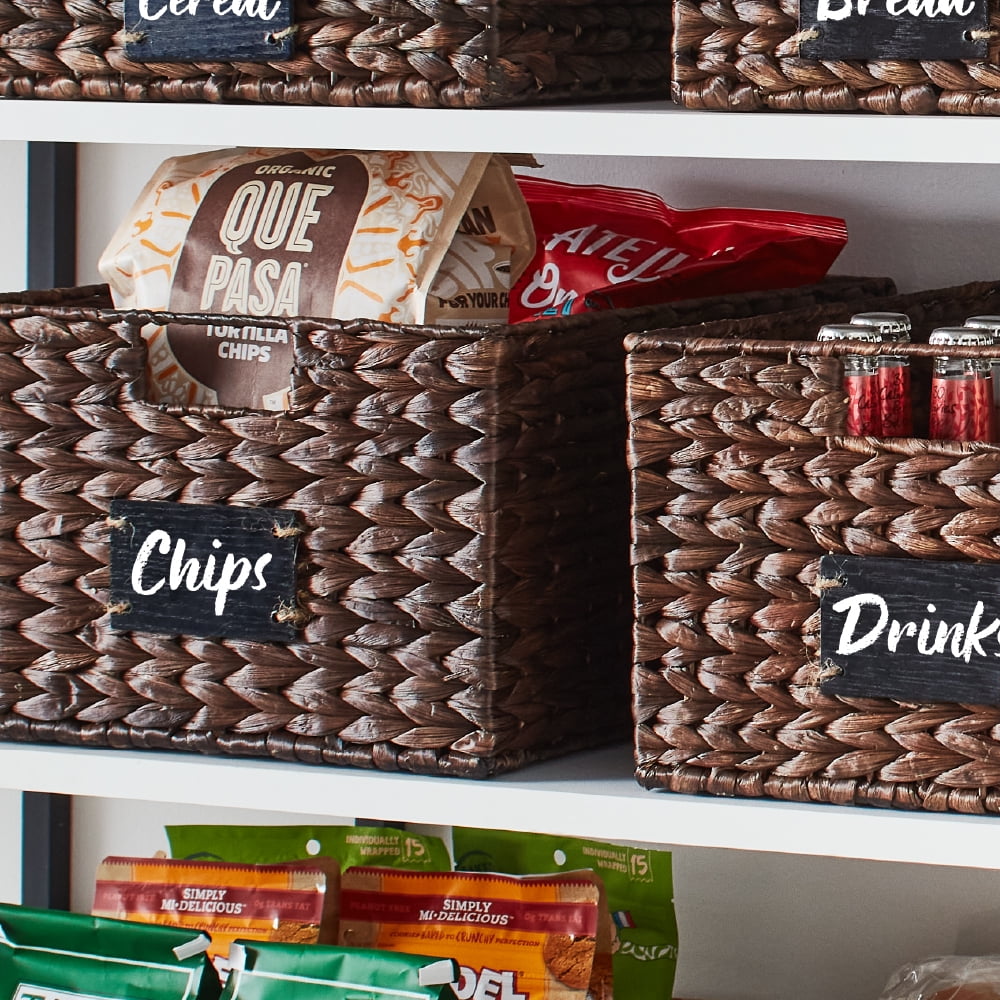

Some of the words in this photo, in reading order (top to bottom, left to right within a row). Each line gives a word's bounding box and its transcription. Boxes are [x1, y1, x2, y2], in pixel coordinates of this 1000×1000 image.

[255, 164, 337, 179] ORGANIC
[219, 179, 335, 255] QUE
[200, 254, 302, 318] PASA
[466, 291, 498, 309] YOUR
[217, 341, 272, 363] CHIPS
[131, 529, 273, 616] Chips
[360, 846, 400, 856] WRAPPED
[405, 837, 425, 857] 15
[630, 854, 648, 876] 15
[183, 887, 227, 901] SIMPLY
[443, 899, 492, 913] SIMPLY
[420, 930, 445, 941] BAKED
[455, 927, 496, 945] CRUNCHY
[495, 937, 541, 948] PERFECTION
